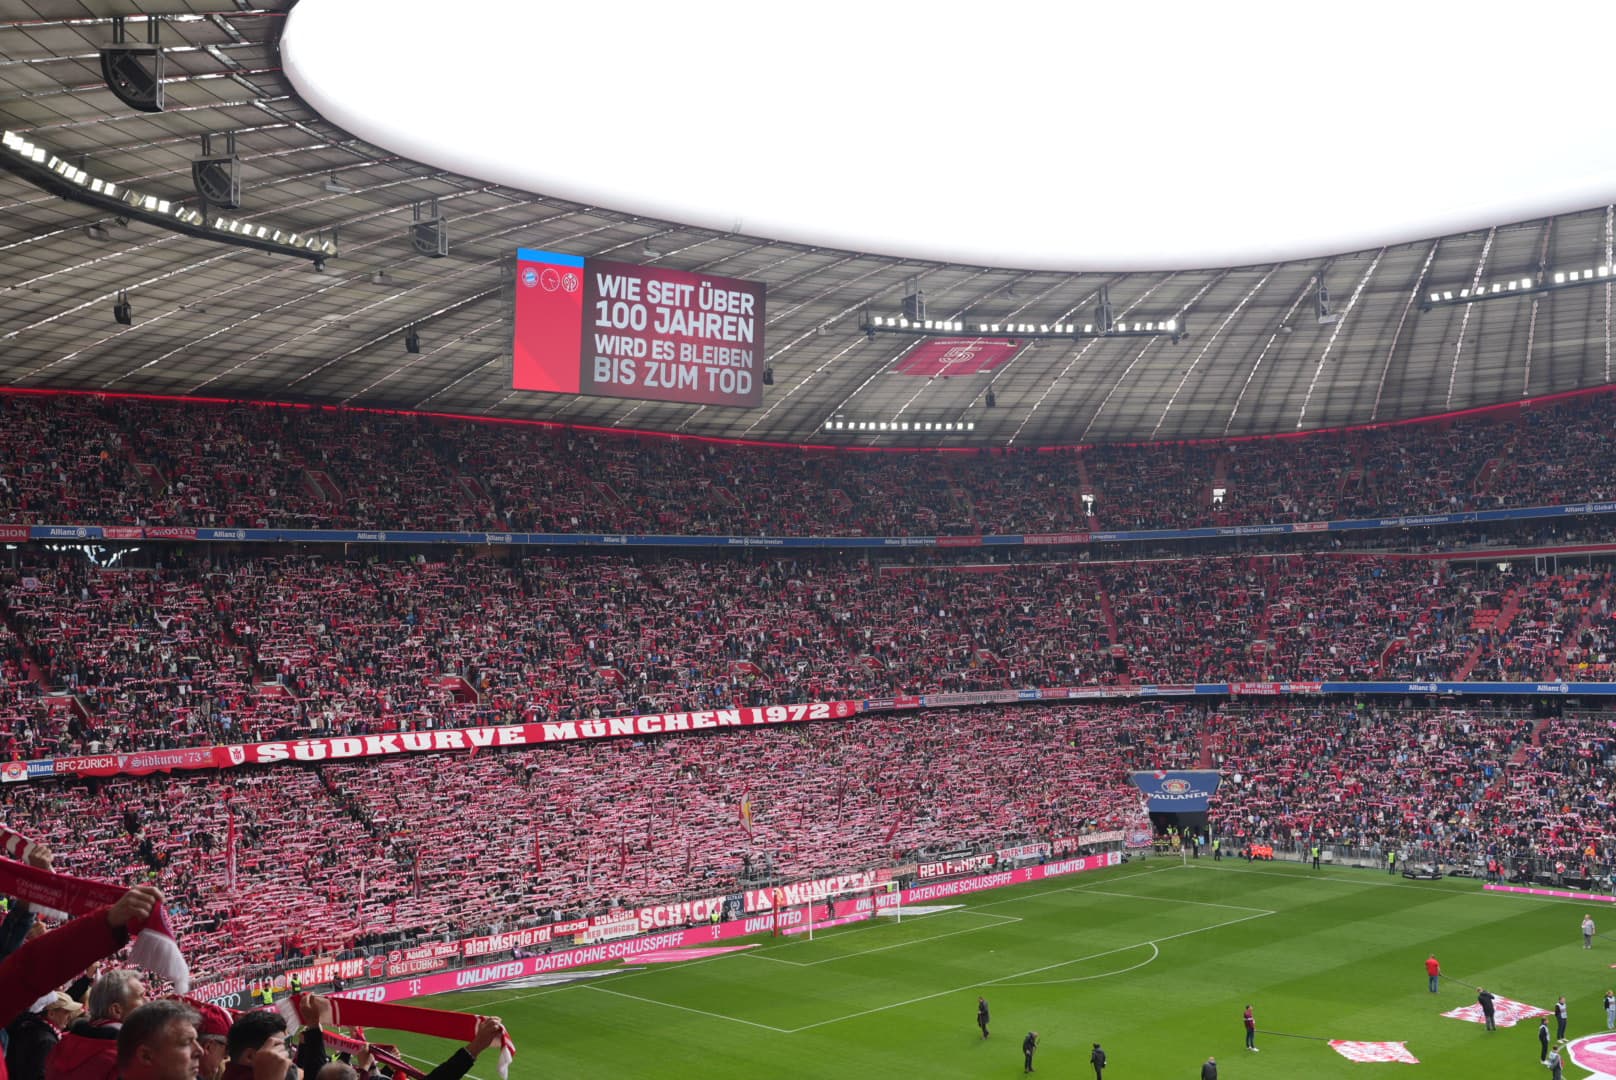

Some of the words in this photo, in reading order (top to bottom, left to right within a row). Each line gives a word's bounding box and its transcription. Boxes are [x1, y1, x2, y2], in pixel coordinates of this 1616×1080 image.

[596, 273, 641, 301] WIE
[646, 280, 694, 307] SEIT
[699, 281, 754, 315] ÜBER
[595, 300, 647, 331] 100
[654, 307, 754, 343] JAHREN
[594, 334, 647, 358] WIRD
[652, 340, 675, 361] ES
[679, 343, 753, 368] BLEIBEN
[593, 356, 636, 385] BIS
[643, 361, 698, 391] ZUM
[705, 367, 752, 394] TOD
[50, 528, 76, 536] Allianz
[256, 725, 526, 763] SÜDKURVE
[543, 709, 742, 741] MÜNCHEN
[752, 703, 831, 724] 1972
[27, 763, 53, 774] Allianz
[56, 761, 76, 771] BFC
[1147, 791, 1208, 800] PAULANER
[1044, 858, 1086, 876] UNLIMITED
[909, 889, 936, 902] DATEN
[936, 883, 959, 897] OHNE
[959, 873, 1013, 892] SCHLUSSPFIFF
[533, 926, 552, 942] rot
[535, 952, 574, 972] DATEN
[574, 946, 607, 965] OHNE
[608, 933, 685, 958] SCHLUSSPFIFF
[390, 963, 408, 976] RED
[410, 959, 445, 972] COBRAS
[456, 962, 524, 986] UNLIMITED
